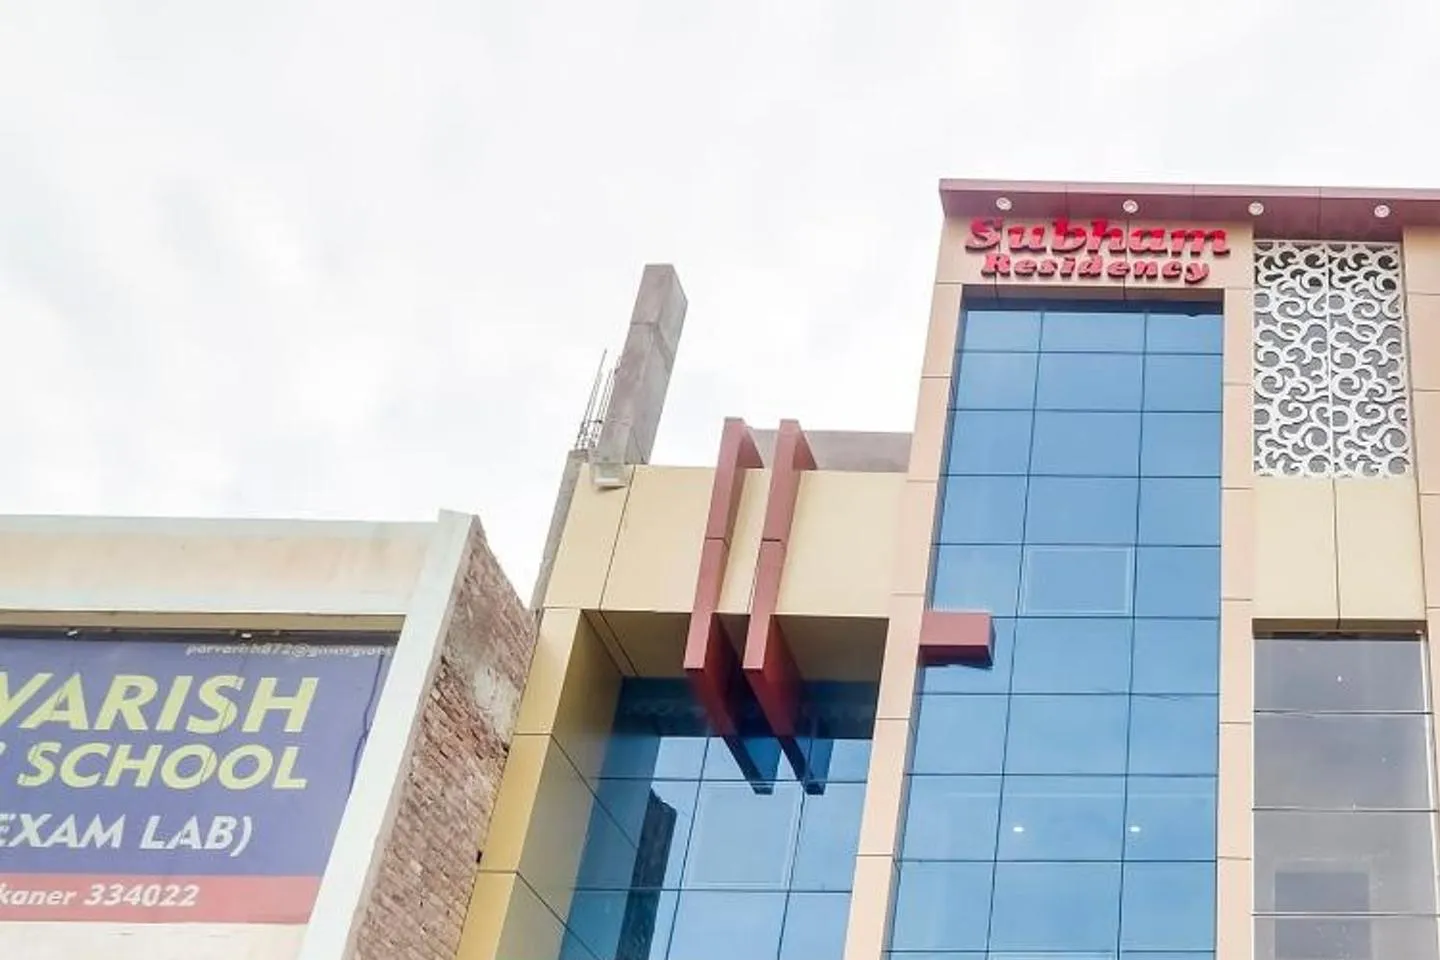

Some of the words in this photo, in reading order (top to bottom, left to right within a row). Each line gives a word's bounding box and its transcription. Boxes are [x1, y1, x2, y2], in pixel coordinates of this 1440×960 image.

[966, 216, 1230, 255] Subham
[981, 253, 1210, 283] Residency
[17, 741, 307, 790] SCHOOL
[139, 815, 253, 857] LAB)
[84, 883, 200, 907] 334022
